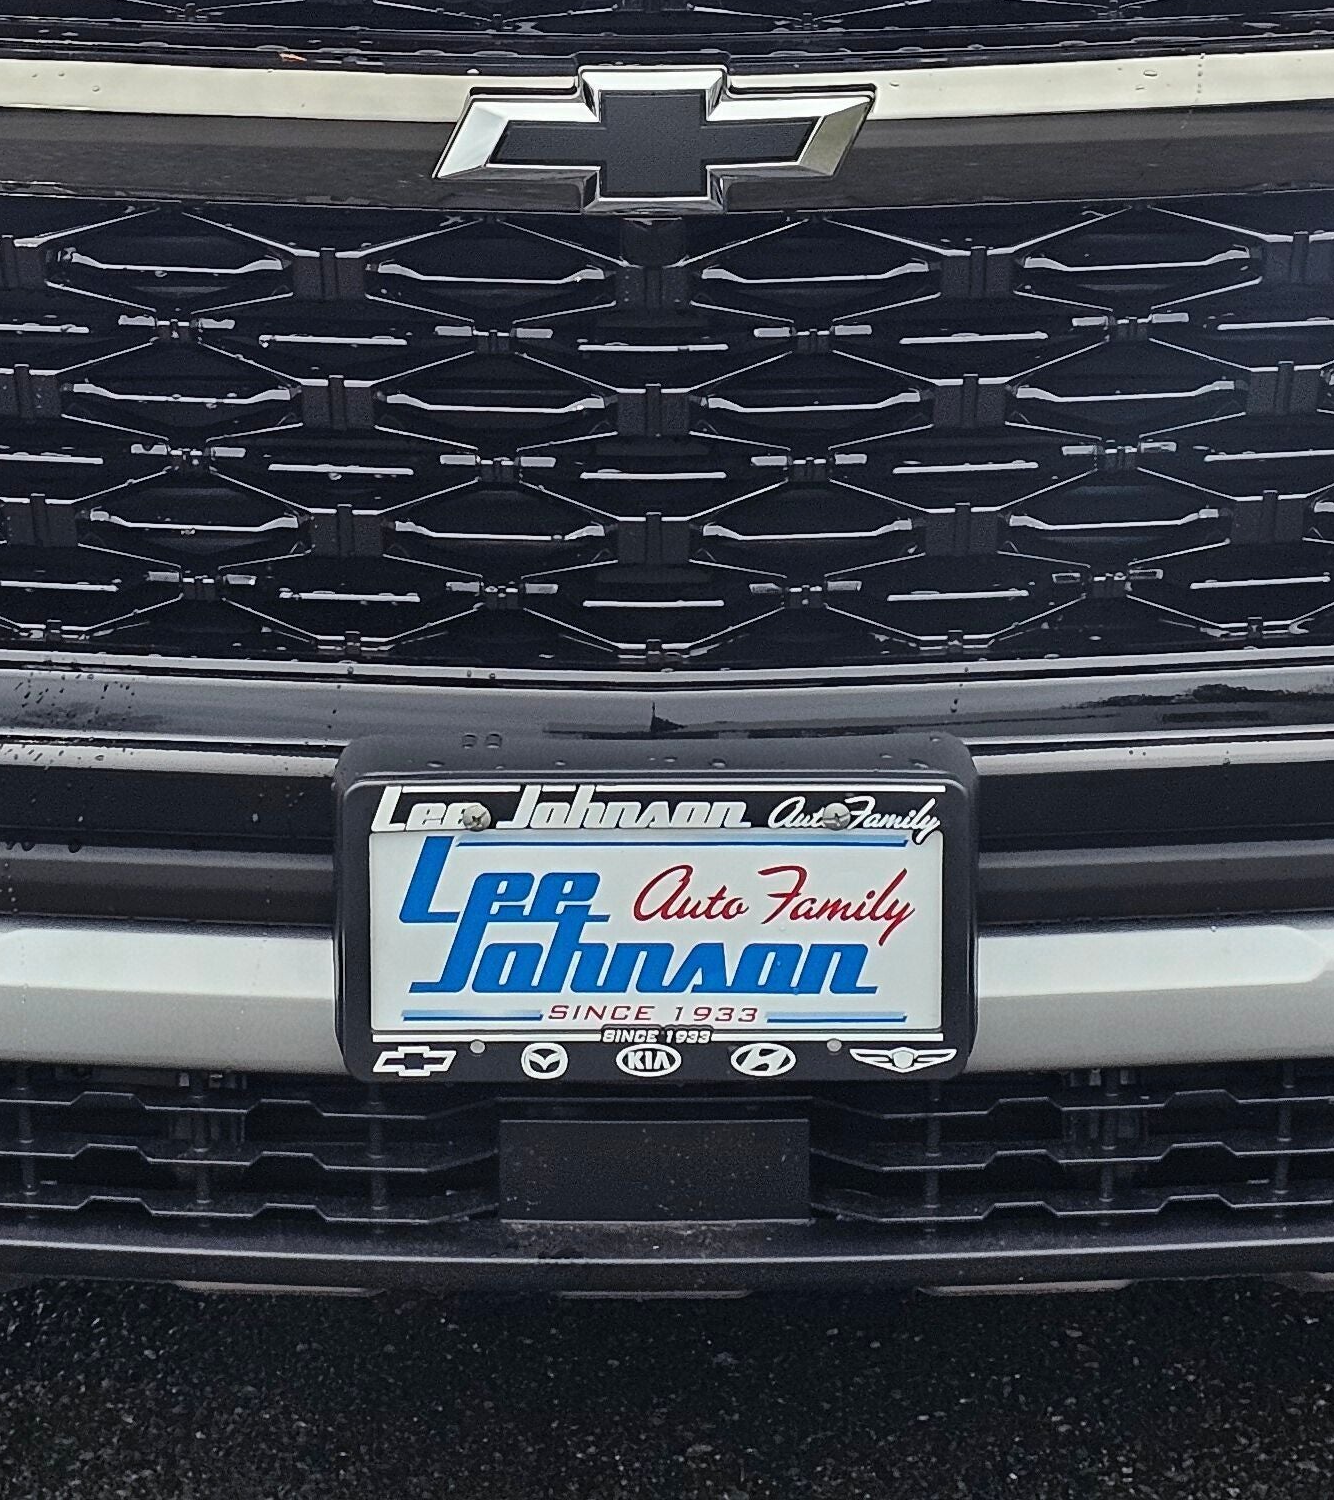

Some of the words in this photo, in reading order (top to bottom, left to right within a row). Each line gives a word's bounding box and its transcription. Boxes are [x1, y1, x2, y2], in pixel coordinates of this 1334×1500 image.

[496, 784, 752, 830] Johnson
[767, 795, 837, 830] Aut
[844, 795, 941, 844] Family
[399, 835, 611, 924] Lee
[633, 864, 750, 921] Auto
[757, 864, 916, 947] Family
[408, 920, 878, 995] Johnson
[547, 1004, 656, 1022] SINCE
[674, 1006, 759, 1023] 1933
[601, 1028, 660, 1044] SINCE
[665, 1029, 713, 1044] 1933
[627, 1050, 672, 1071] KIA
